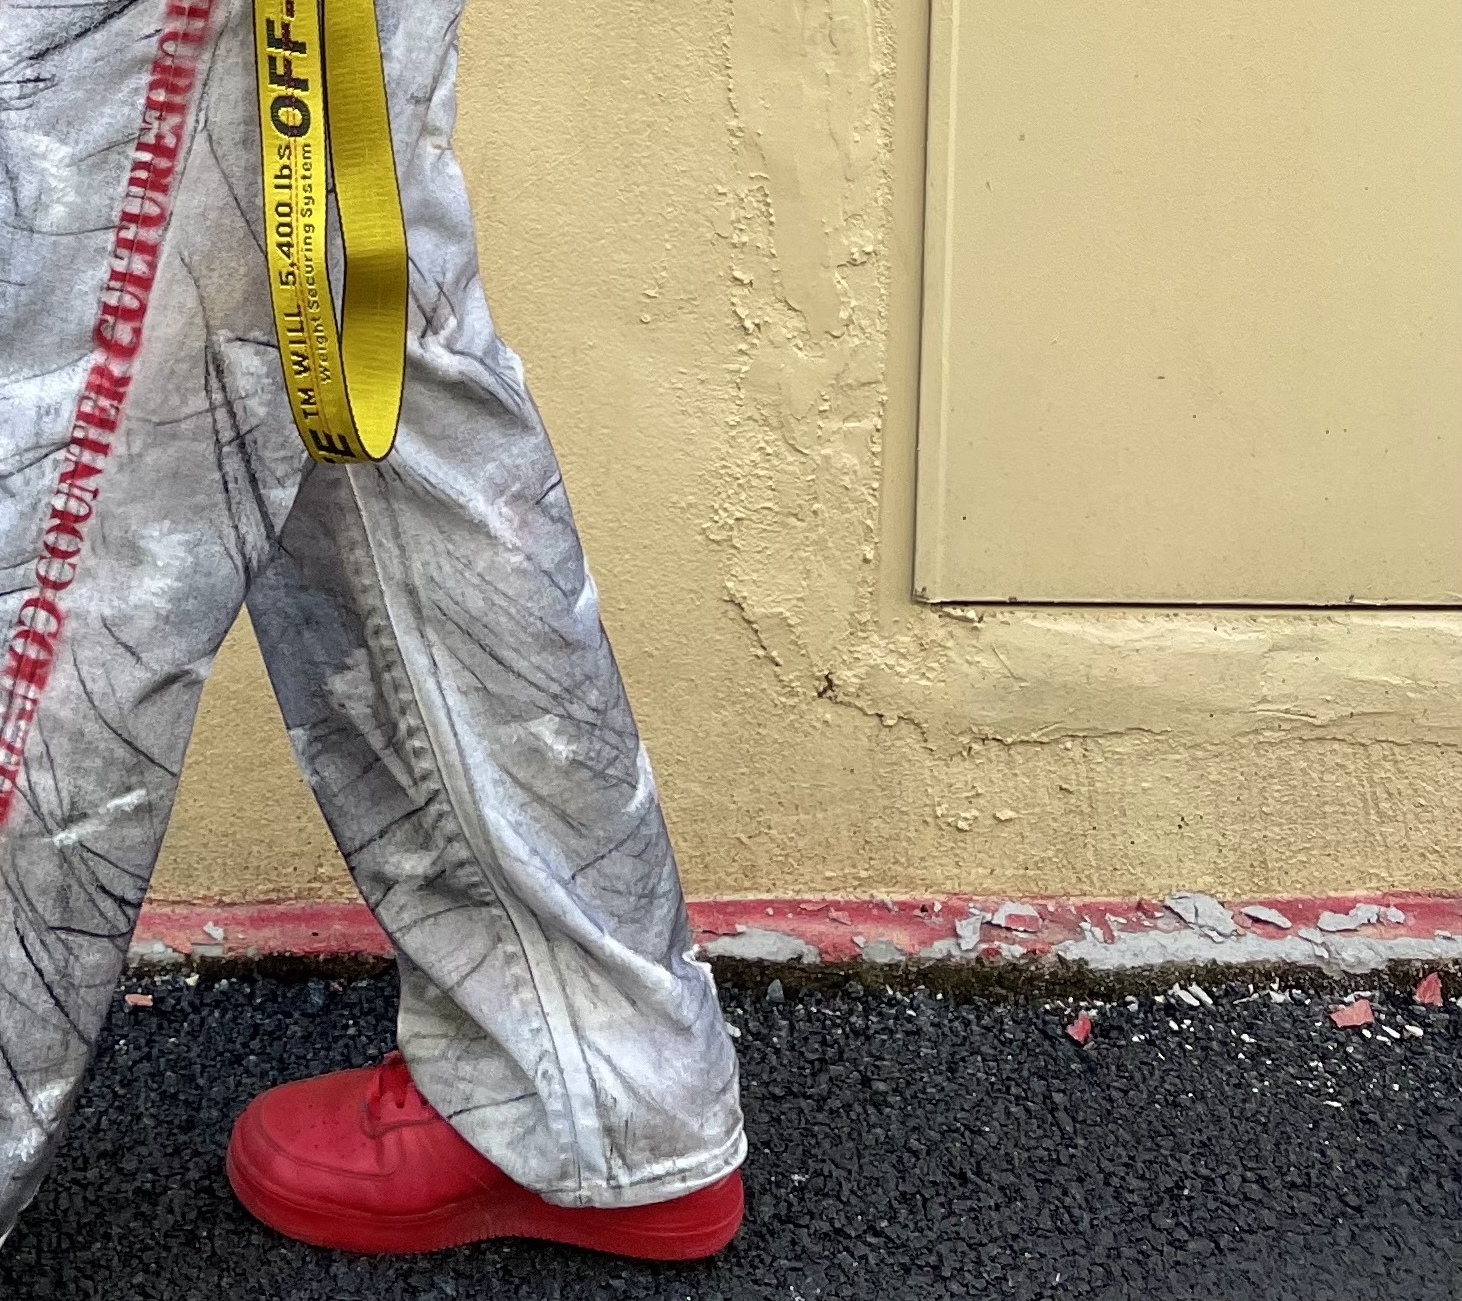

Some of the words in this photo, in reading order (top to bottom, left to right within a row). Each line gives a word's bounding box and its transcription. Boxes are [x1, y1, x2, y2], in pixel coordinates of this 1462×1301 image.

[273, 143, 293, 190] lbs
[297, 142, 315, 218] System
[274, 202, 298, 288] 5,400
[301, 223, 322, 313] Securing
[283, 305, 310, 377] WILL
[298, 388, 320, 419] TM
